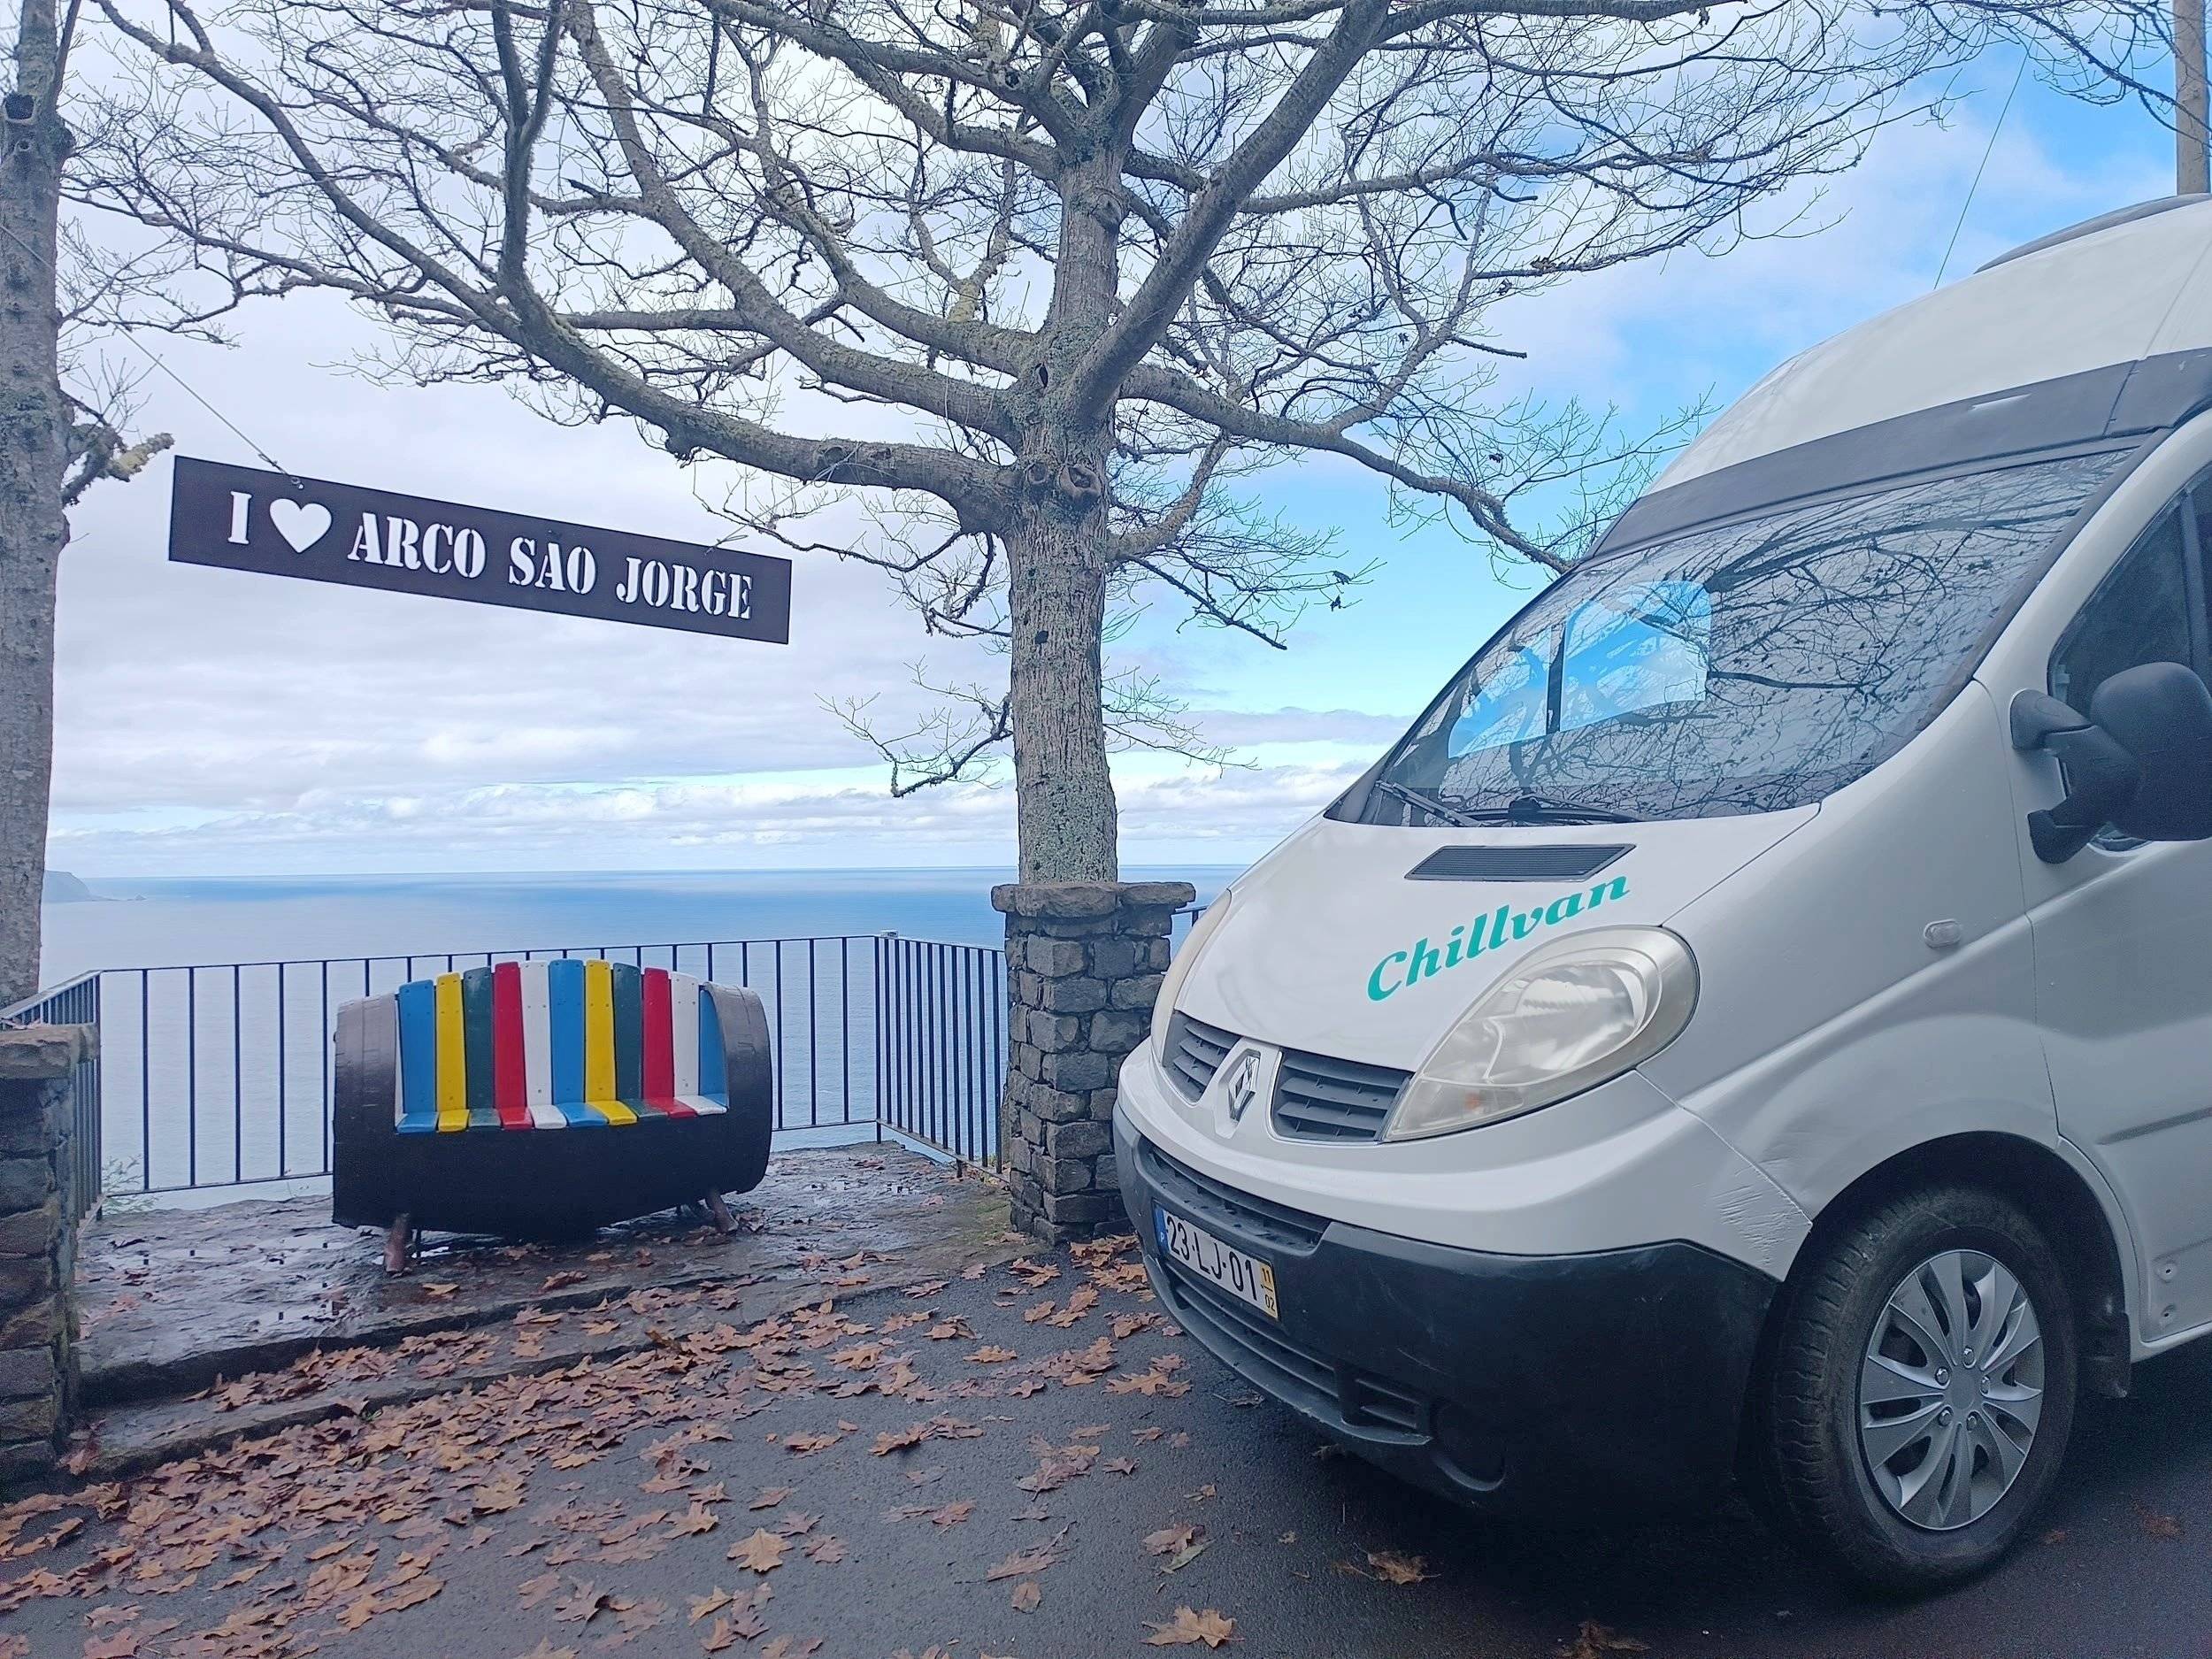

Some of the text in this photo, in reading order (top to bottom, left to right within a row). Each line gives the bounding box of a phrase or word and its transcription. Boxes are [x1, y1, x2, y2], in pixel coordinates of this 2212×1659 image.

[227, 491, 251, 544] I
[347, 511, 488, 578] ARCO
[616, 557, 754, 619] JORGE
[1367, 875, 1631, 1001] Chillvan
[1262, 1267, 1271, 1284] 11
[1264, 1294, 1276, 1311] 02
